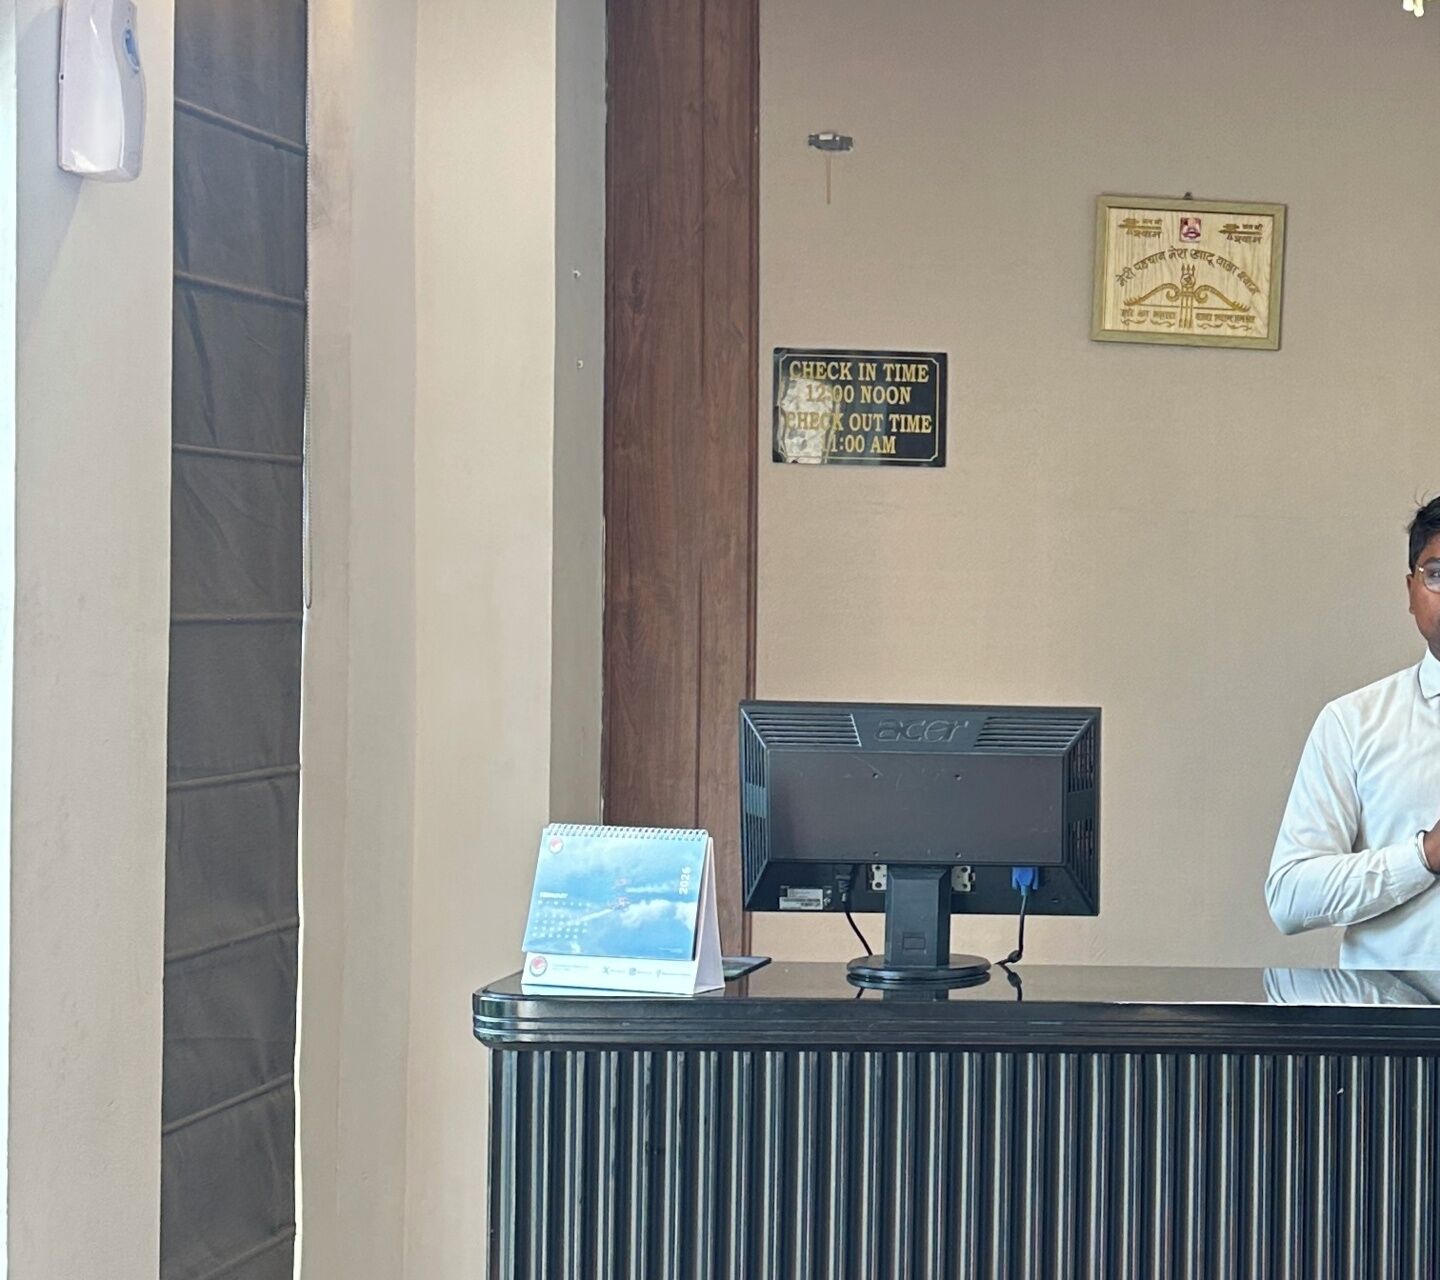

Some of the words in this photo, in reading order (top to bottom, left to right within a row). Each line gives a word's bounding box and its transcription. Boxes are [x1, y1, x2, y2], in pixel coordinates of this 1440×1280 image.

[788, 360, 853, 381] CHECK
[858, 362, 877, 381] IN
[882, 363, 930, 383] TIME
[860, 385, 912, 405] NOON
[786, 411, 844, 432] CHECK
[848, 413, 884, 432] OUT
[889, 414, 933, 433] TIME
[870, 435, 897, 454] AM
[678, 864, 692, 896] 2026
